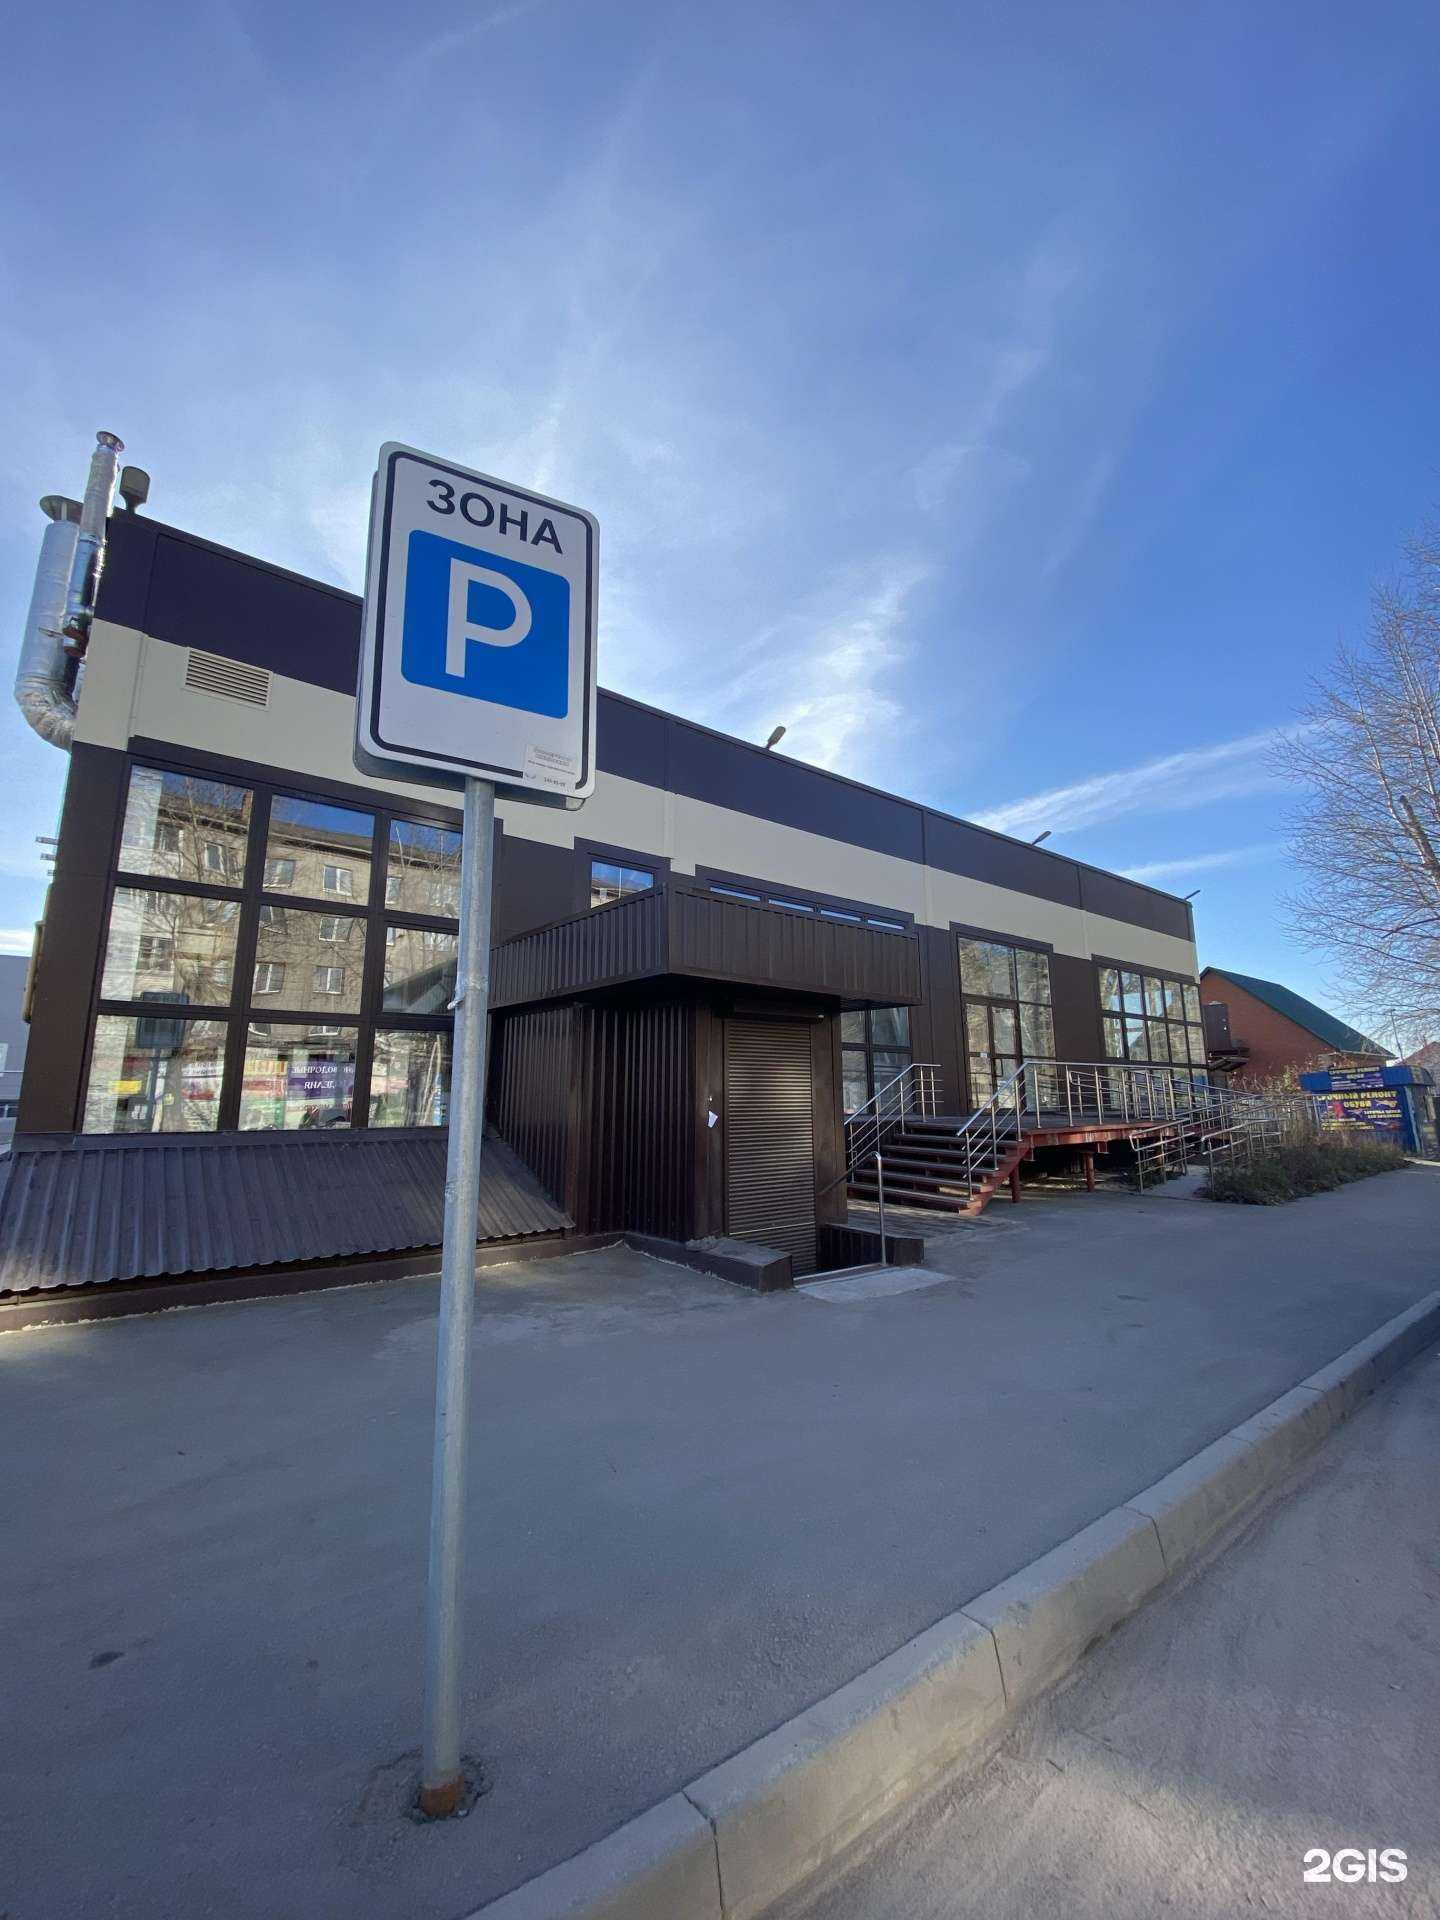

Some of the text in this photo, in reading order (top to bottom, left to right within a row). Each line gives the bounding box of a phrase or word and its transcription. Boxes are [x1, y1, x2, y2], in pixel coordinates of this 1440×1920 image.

[426, 479, 563, 554] ЗОНА
[445, 557, 533, 678] P
[1360, 1091, 1398, 1099] РЕМОНТ
